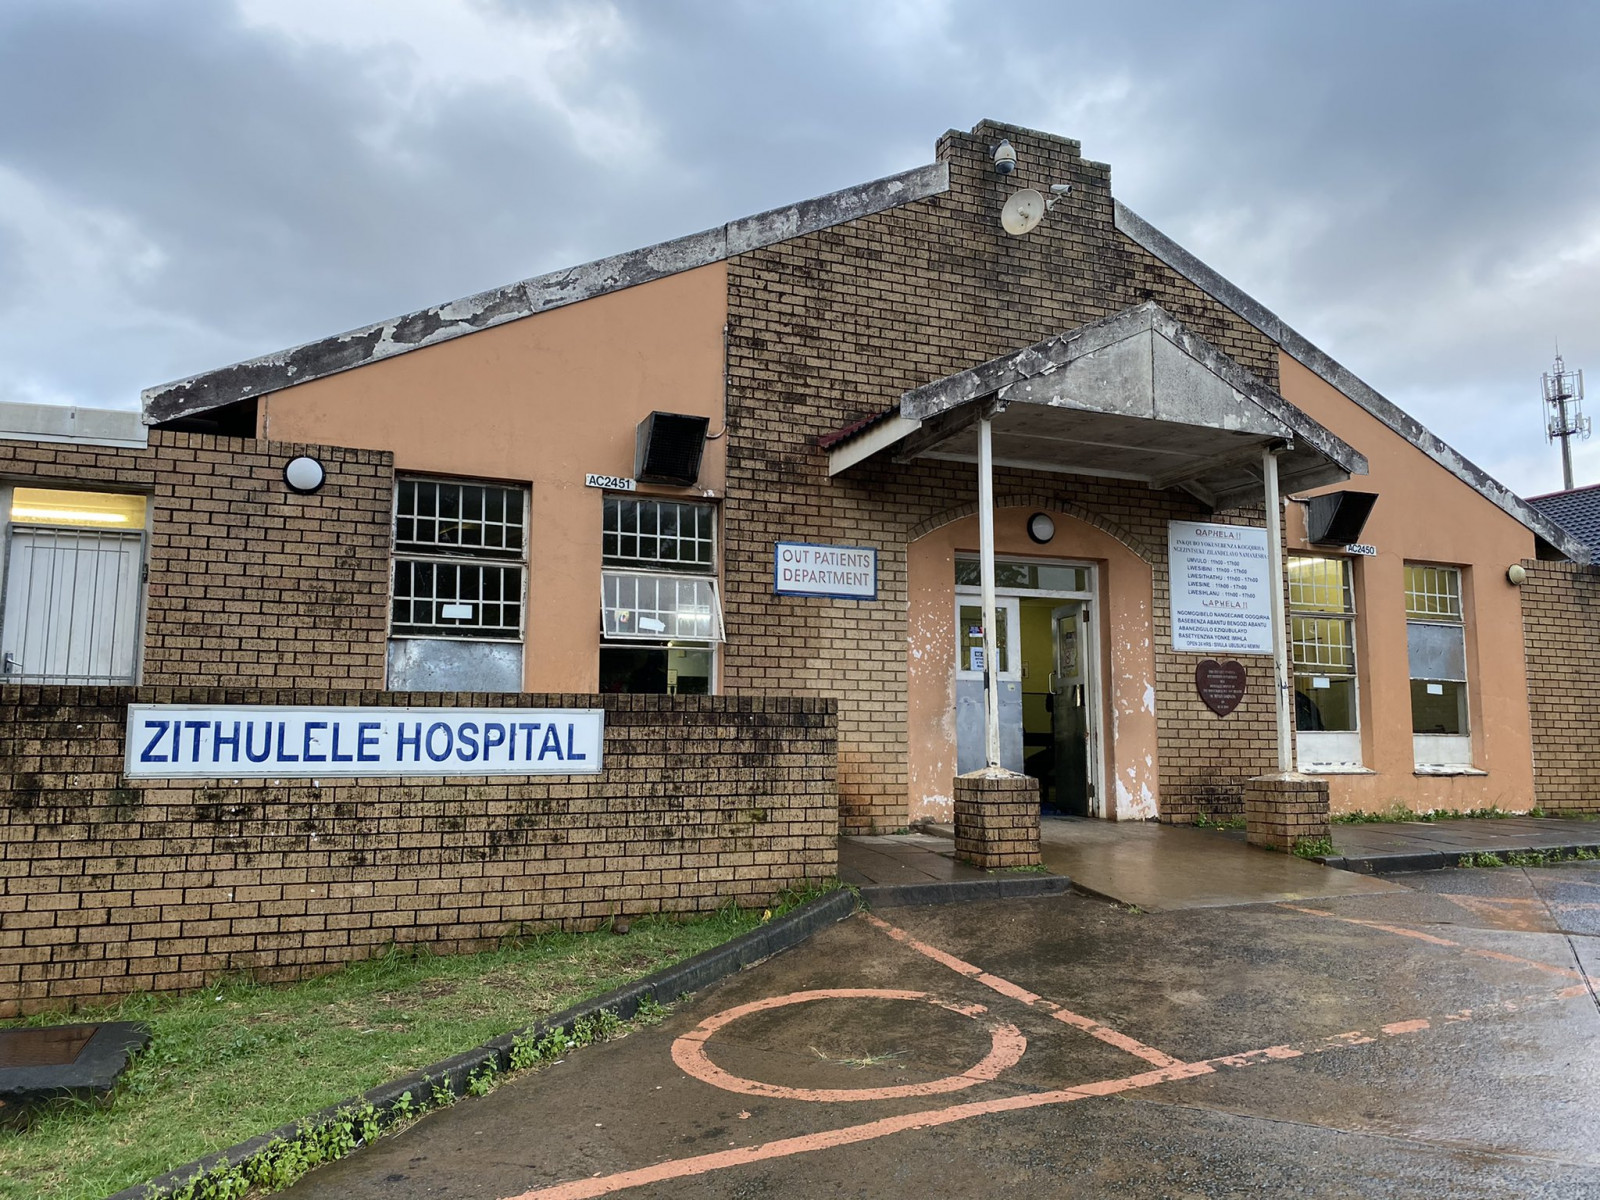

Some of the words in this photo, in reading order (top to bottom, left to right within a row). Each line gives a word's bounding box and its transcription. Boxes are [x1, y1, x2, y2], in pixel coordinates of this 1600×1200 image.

[589, 476, 630, 489] AC2451
[1196, 529, 1234, 538] QAPHELA
[1348, 544, 1374, 554] AC2450
[782, 549, 809, 563] OUT
[814, 552, 870, 568] PATIENTS
[784, 568, 869, 586] DEPARTMENT
[140, 720, 382, 763] ZITHULELE
[397, 722, 586, 762] HOSPITAL
